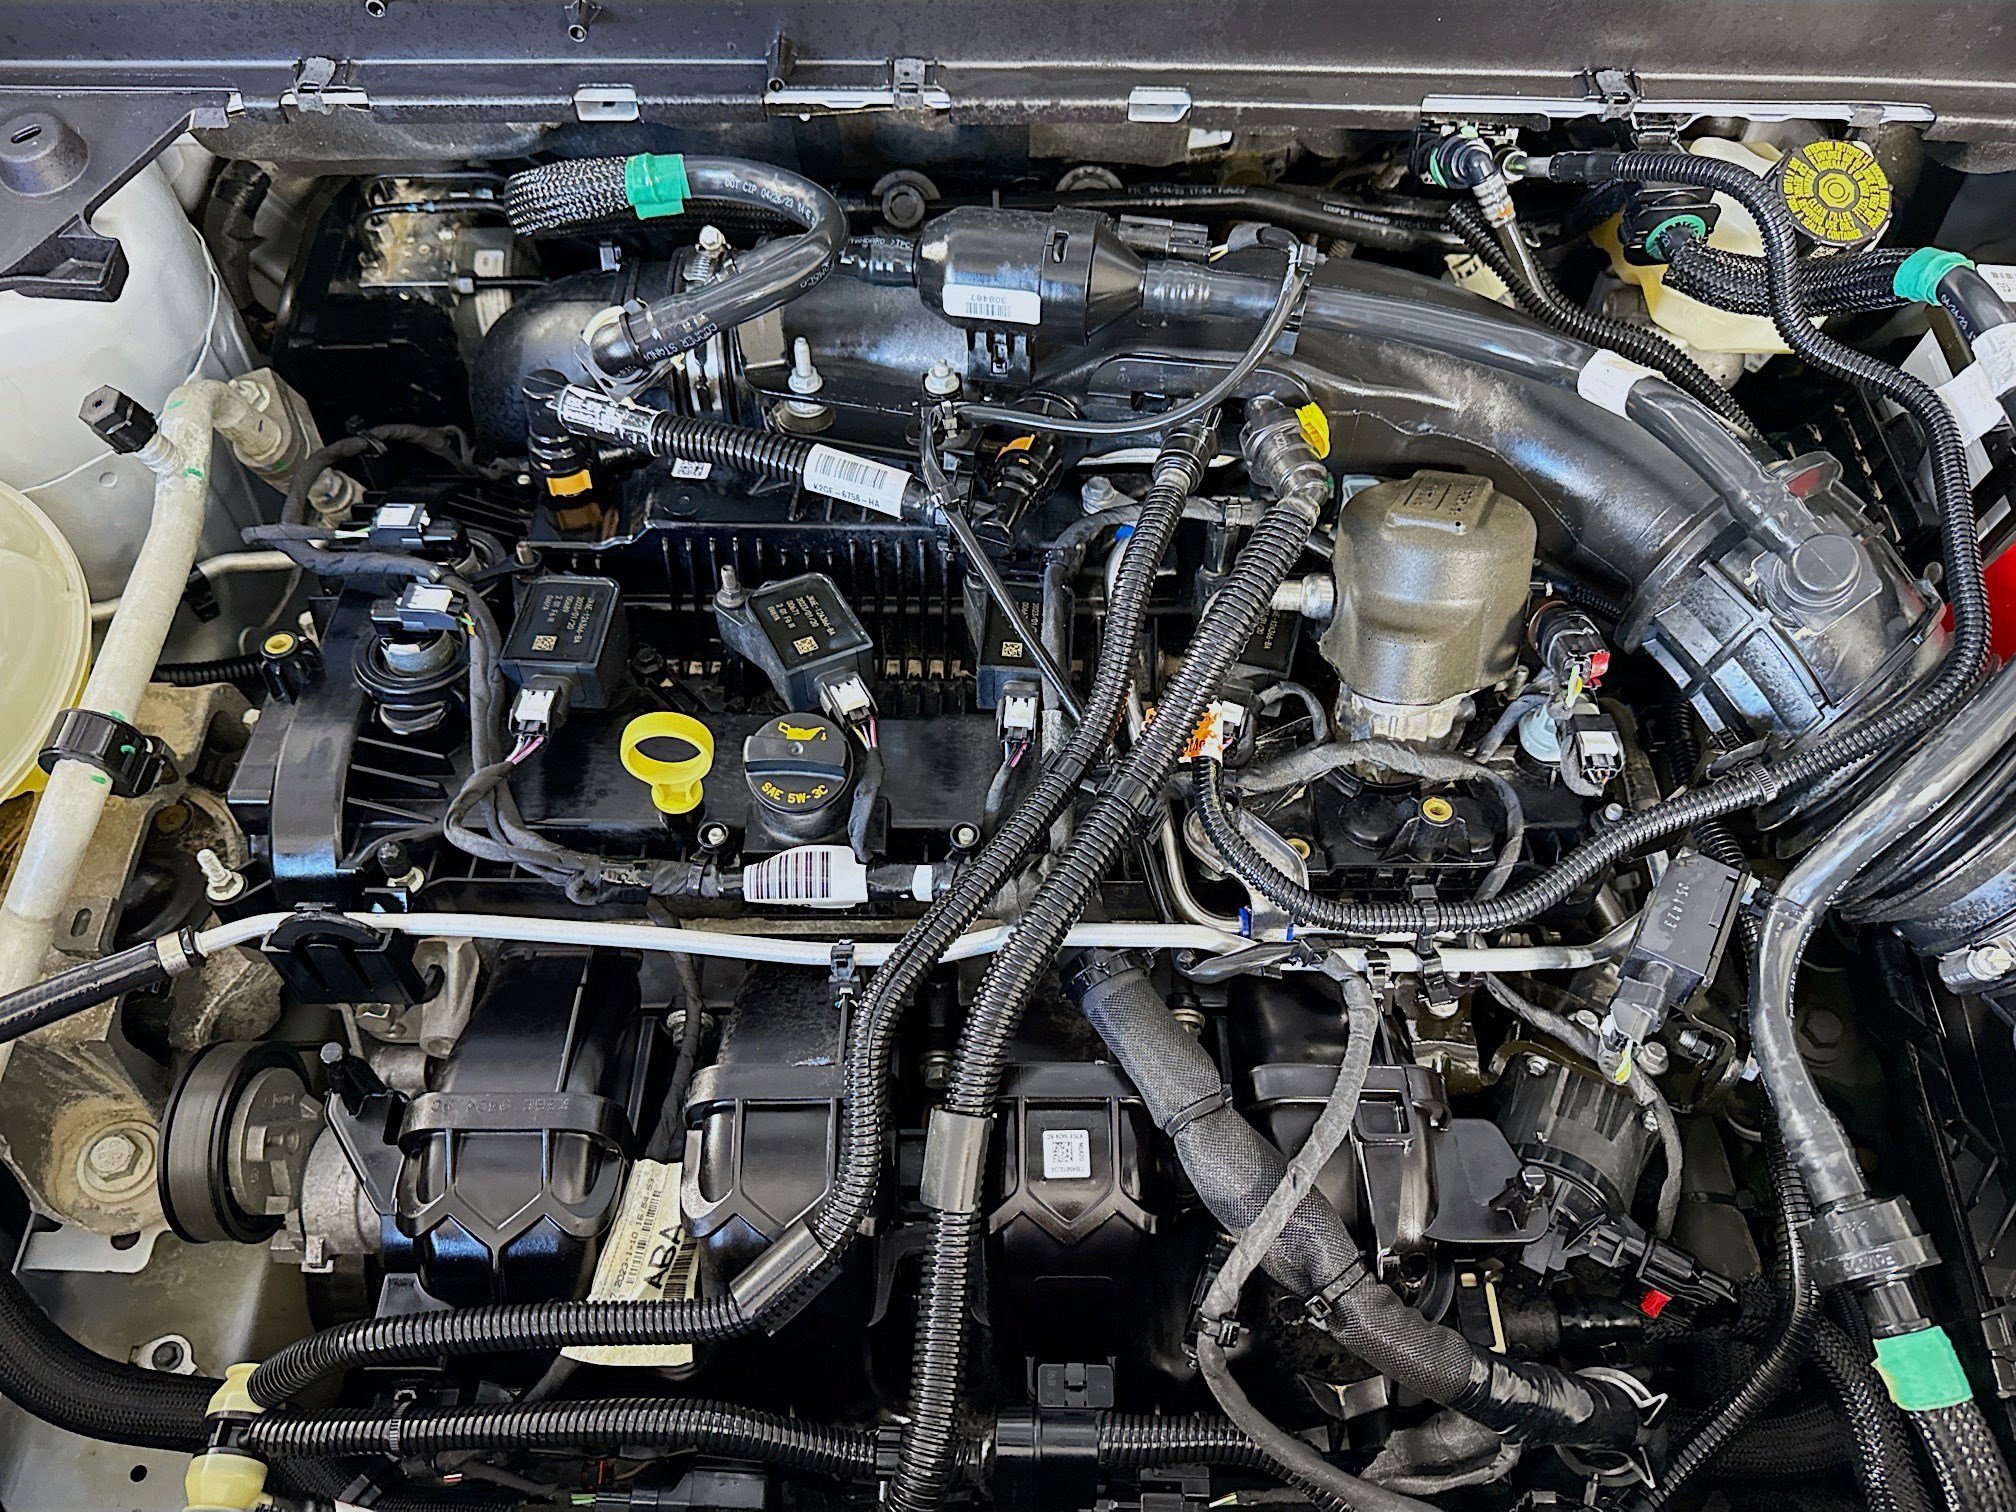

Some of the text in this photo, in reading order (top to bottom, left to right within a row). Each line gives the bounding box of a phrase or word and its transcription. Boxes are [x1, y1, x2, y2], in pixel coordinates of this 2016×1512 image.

[724, 178, 740, 189] DOT
[742, 182, 758, 194] CIP
[1323, 204, 1350, 216] COOPER
[796, 597, 819, 628] 2023/01/20
[762, 782, 784, 800] SAE
[614, 1232, 638, 1288] 2023-1-10
[643, 1224, 682, 1289] ABA
